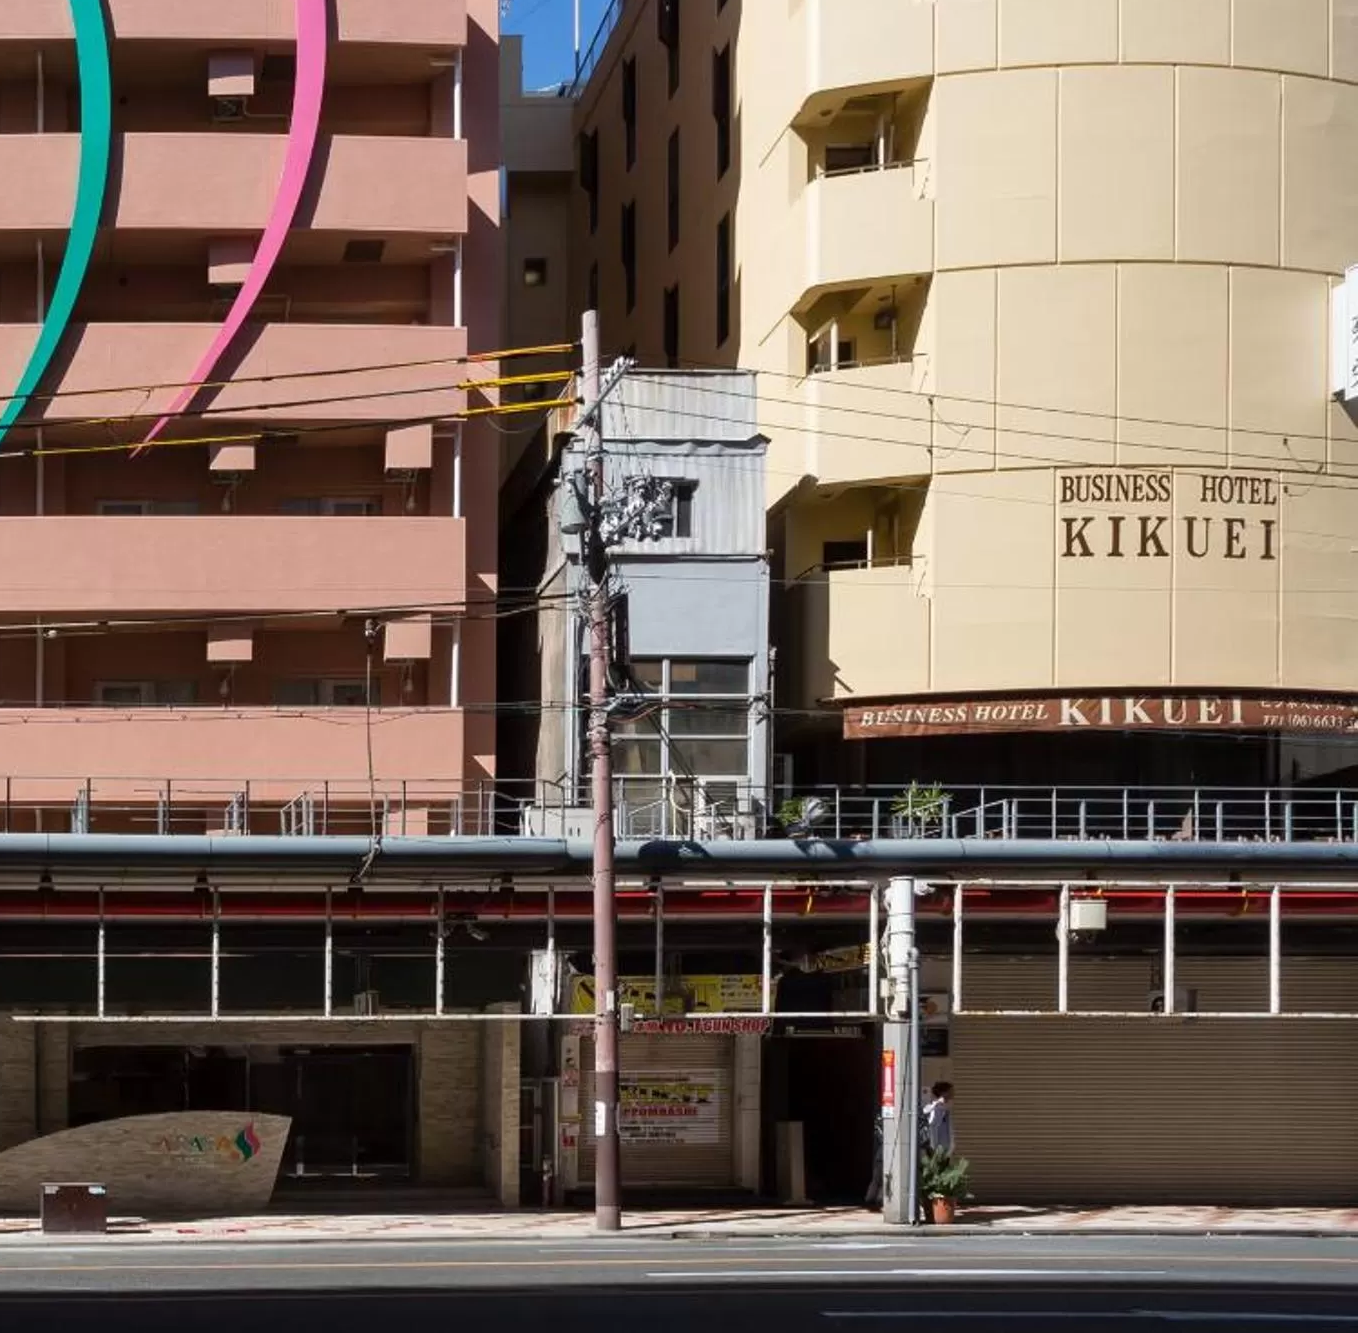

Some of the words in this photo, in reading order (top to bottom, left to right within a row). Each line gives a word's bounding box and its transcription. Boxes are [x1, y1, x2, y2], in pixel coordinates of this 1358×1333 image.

[1060, 474, 1171, 504] BUSINESS
[1200, 475, 1277, 505] HOTEL
[1061, 516, 1276, 560] KIKUEI
[861, 706, 967, 727] BUSINESS
[975, 704, 1049, 721] HOTEL
[1058, 696, 1244, 726] KIKUEI
